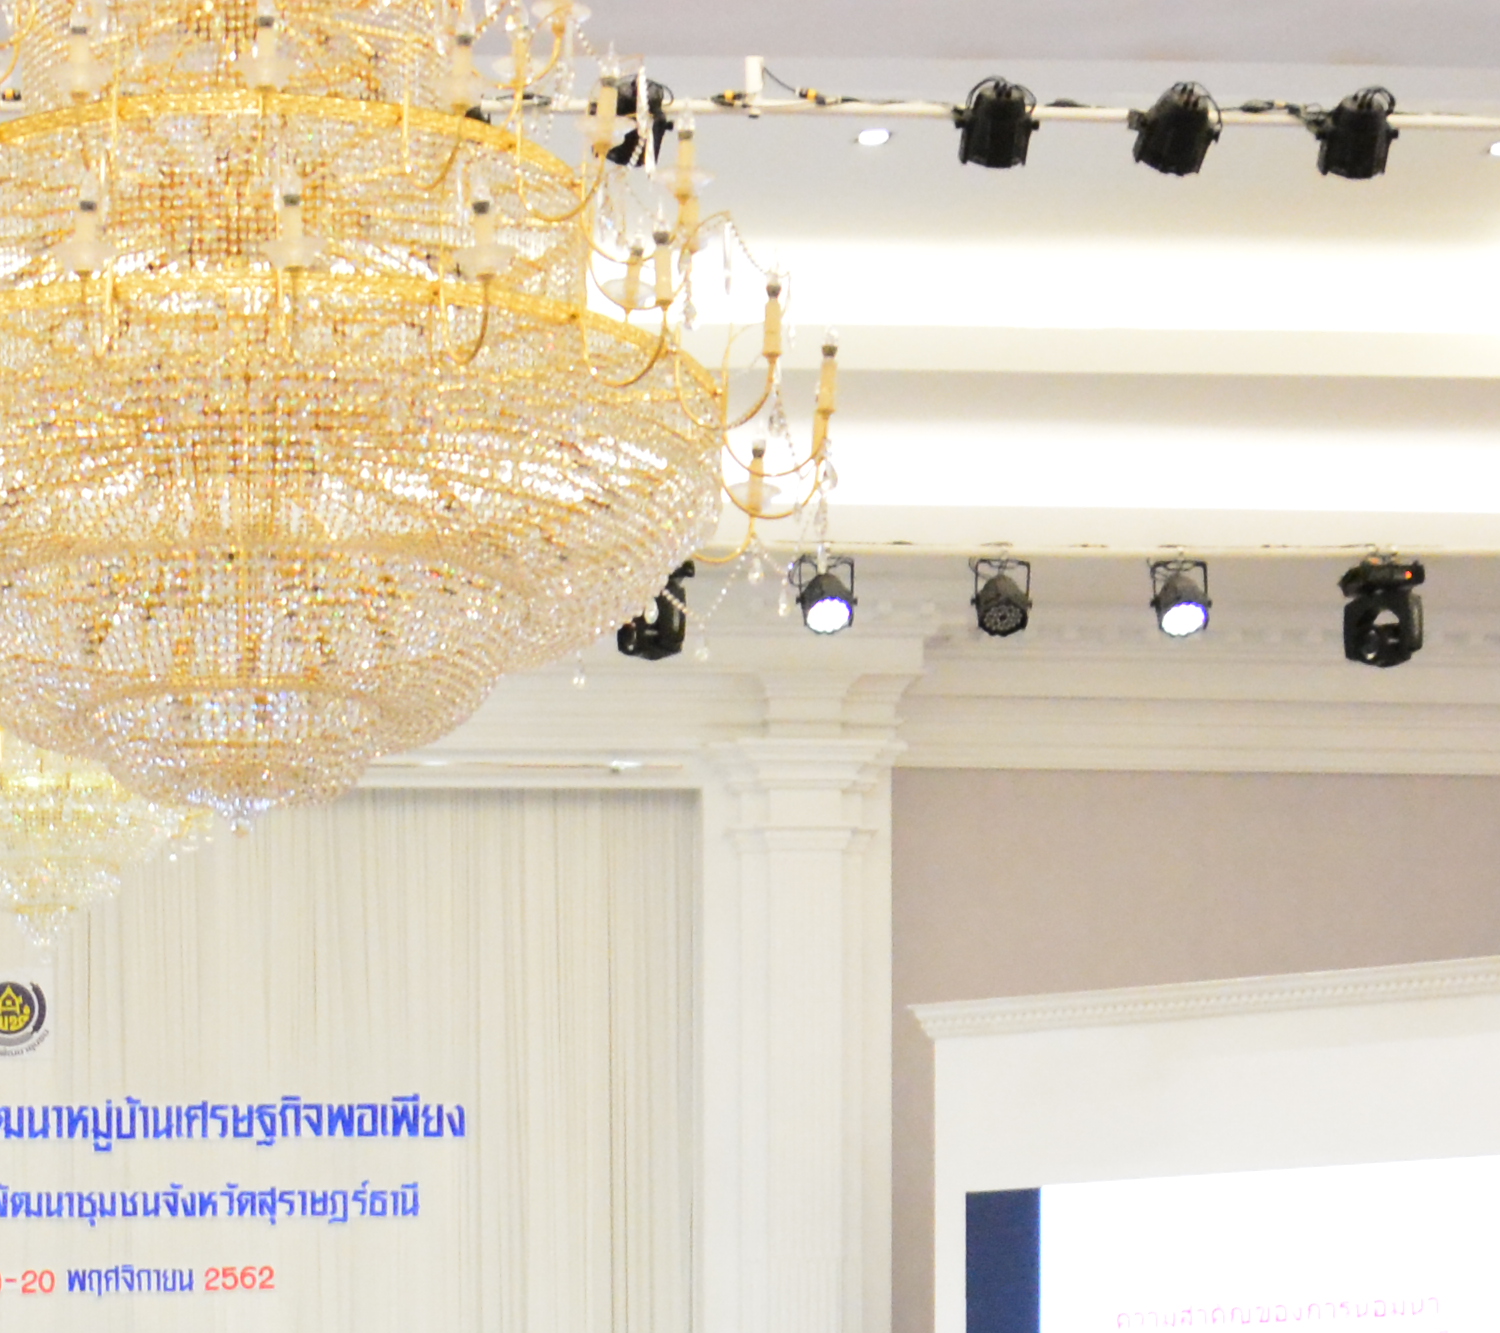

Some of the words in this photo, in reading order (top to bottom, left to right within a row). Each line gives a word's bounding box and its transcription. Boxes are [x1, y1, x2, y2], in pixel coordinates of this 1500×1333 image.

[67, 1264, 194, 1297] พฤศจิกายน
[204, 1265, 275, 1291] 2562
